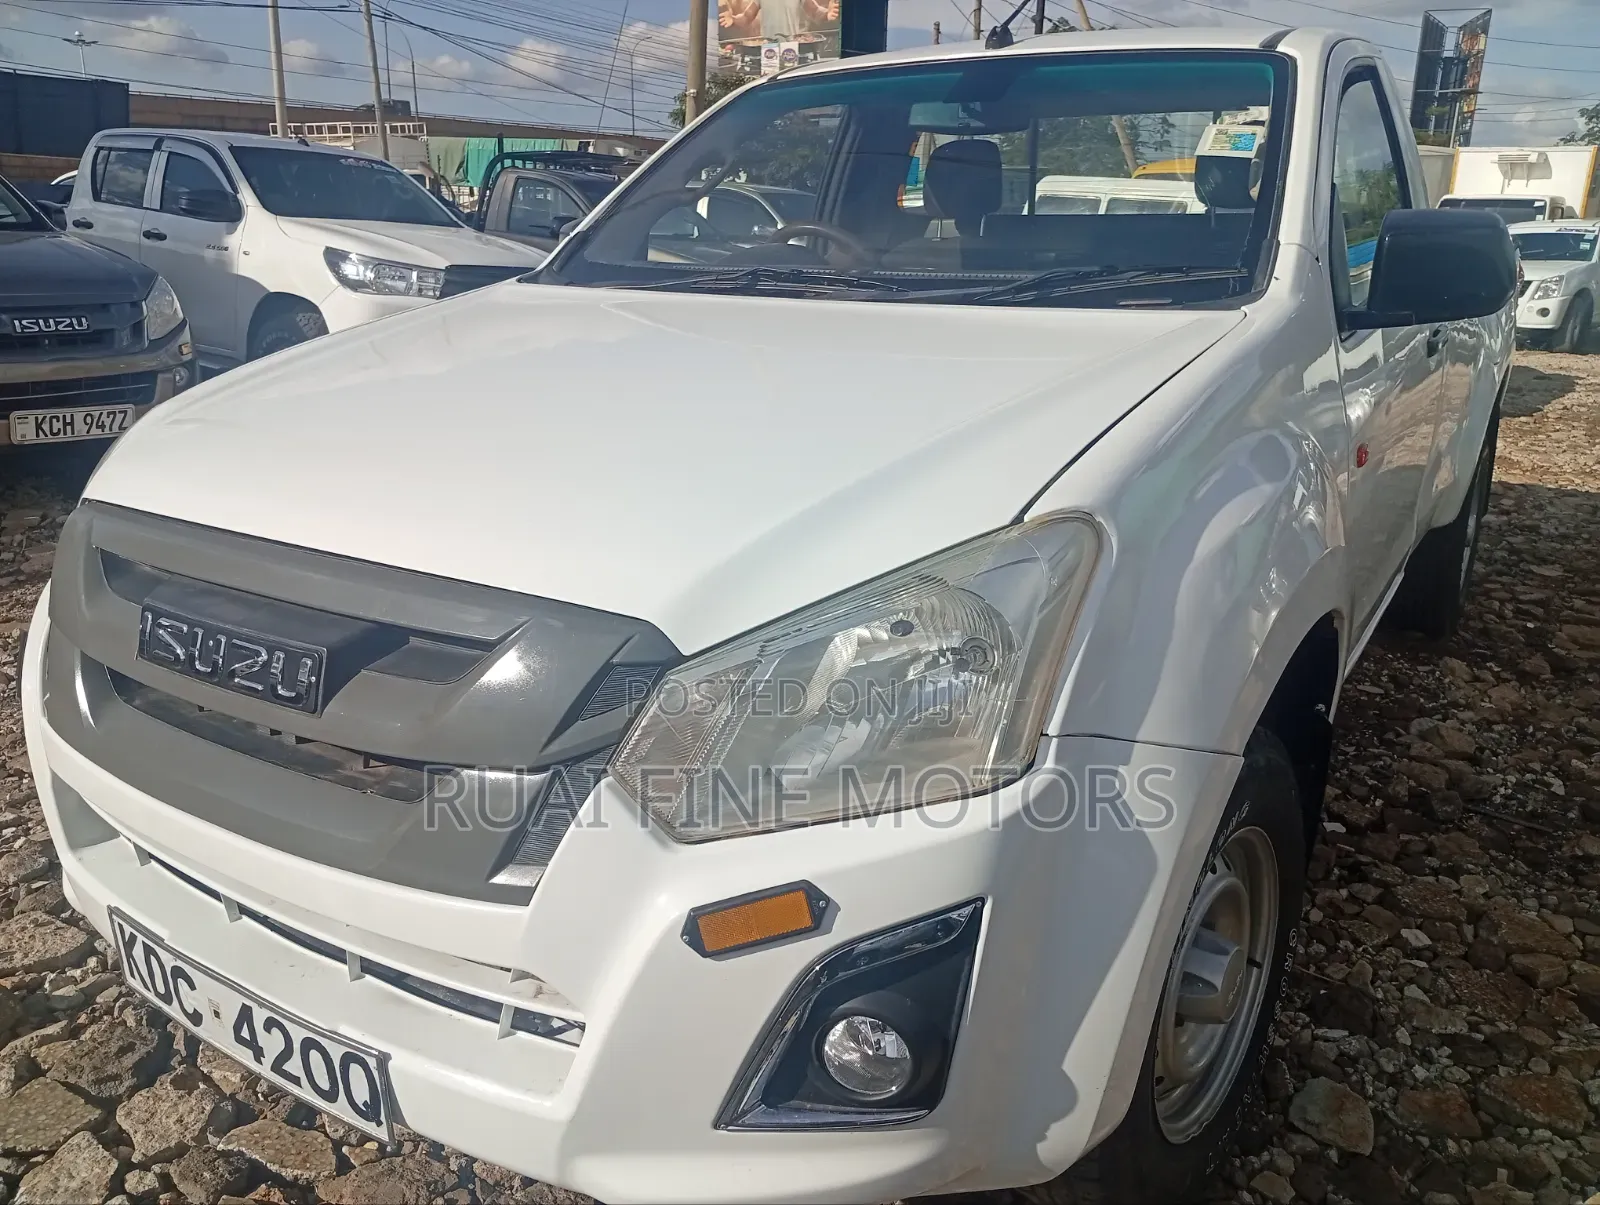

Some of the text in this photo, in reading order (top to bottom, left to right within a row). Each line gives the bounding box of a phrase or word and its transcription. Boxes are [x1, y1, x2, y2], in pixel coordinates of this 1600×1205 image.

[13, 317, 89, 333] ISUZU
[34, 410, 129, 439] KCH 947Z
[140, 611, 314, 706] ISUZU
[118, 922, 384, 1128] KDC 420Q
